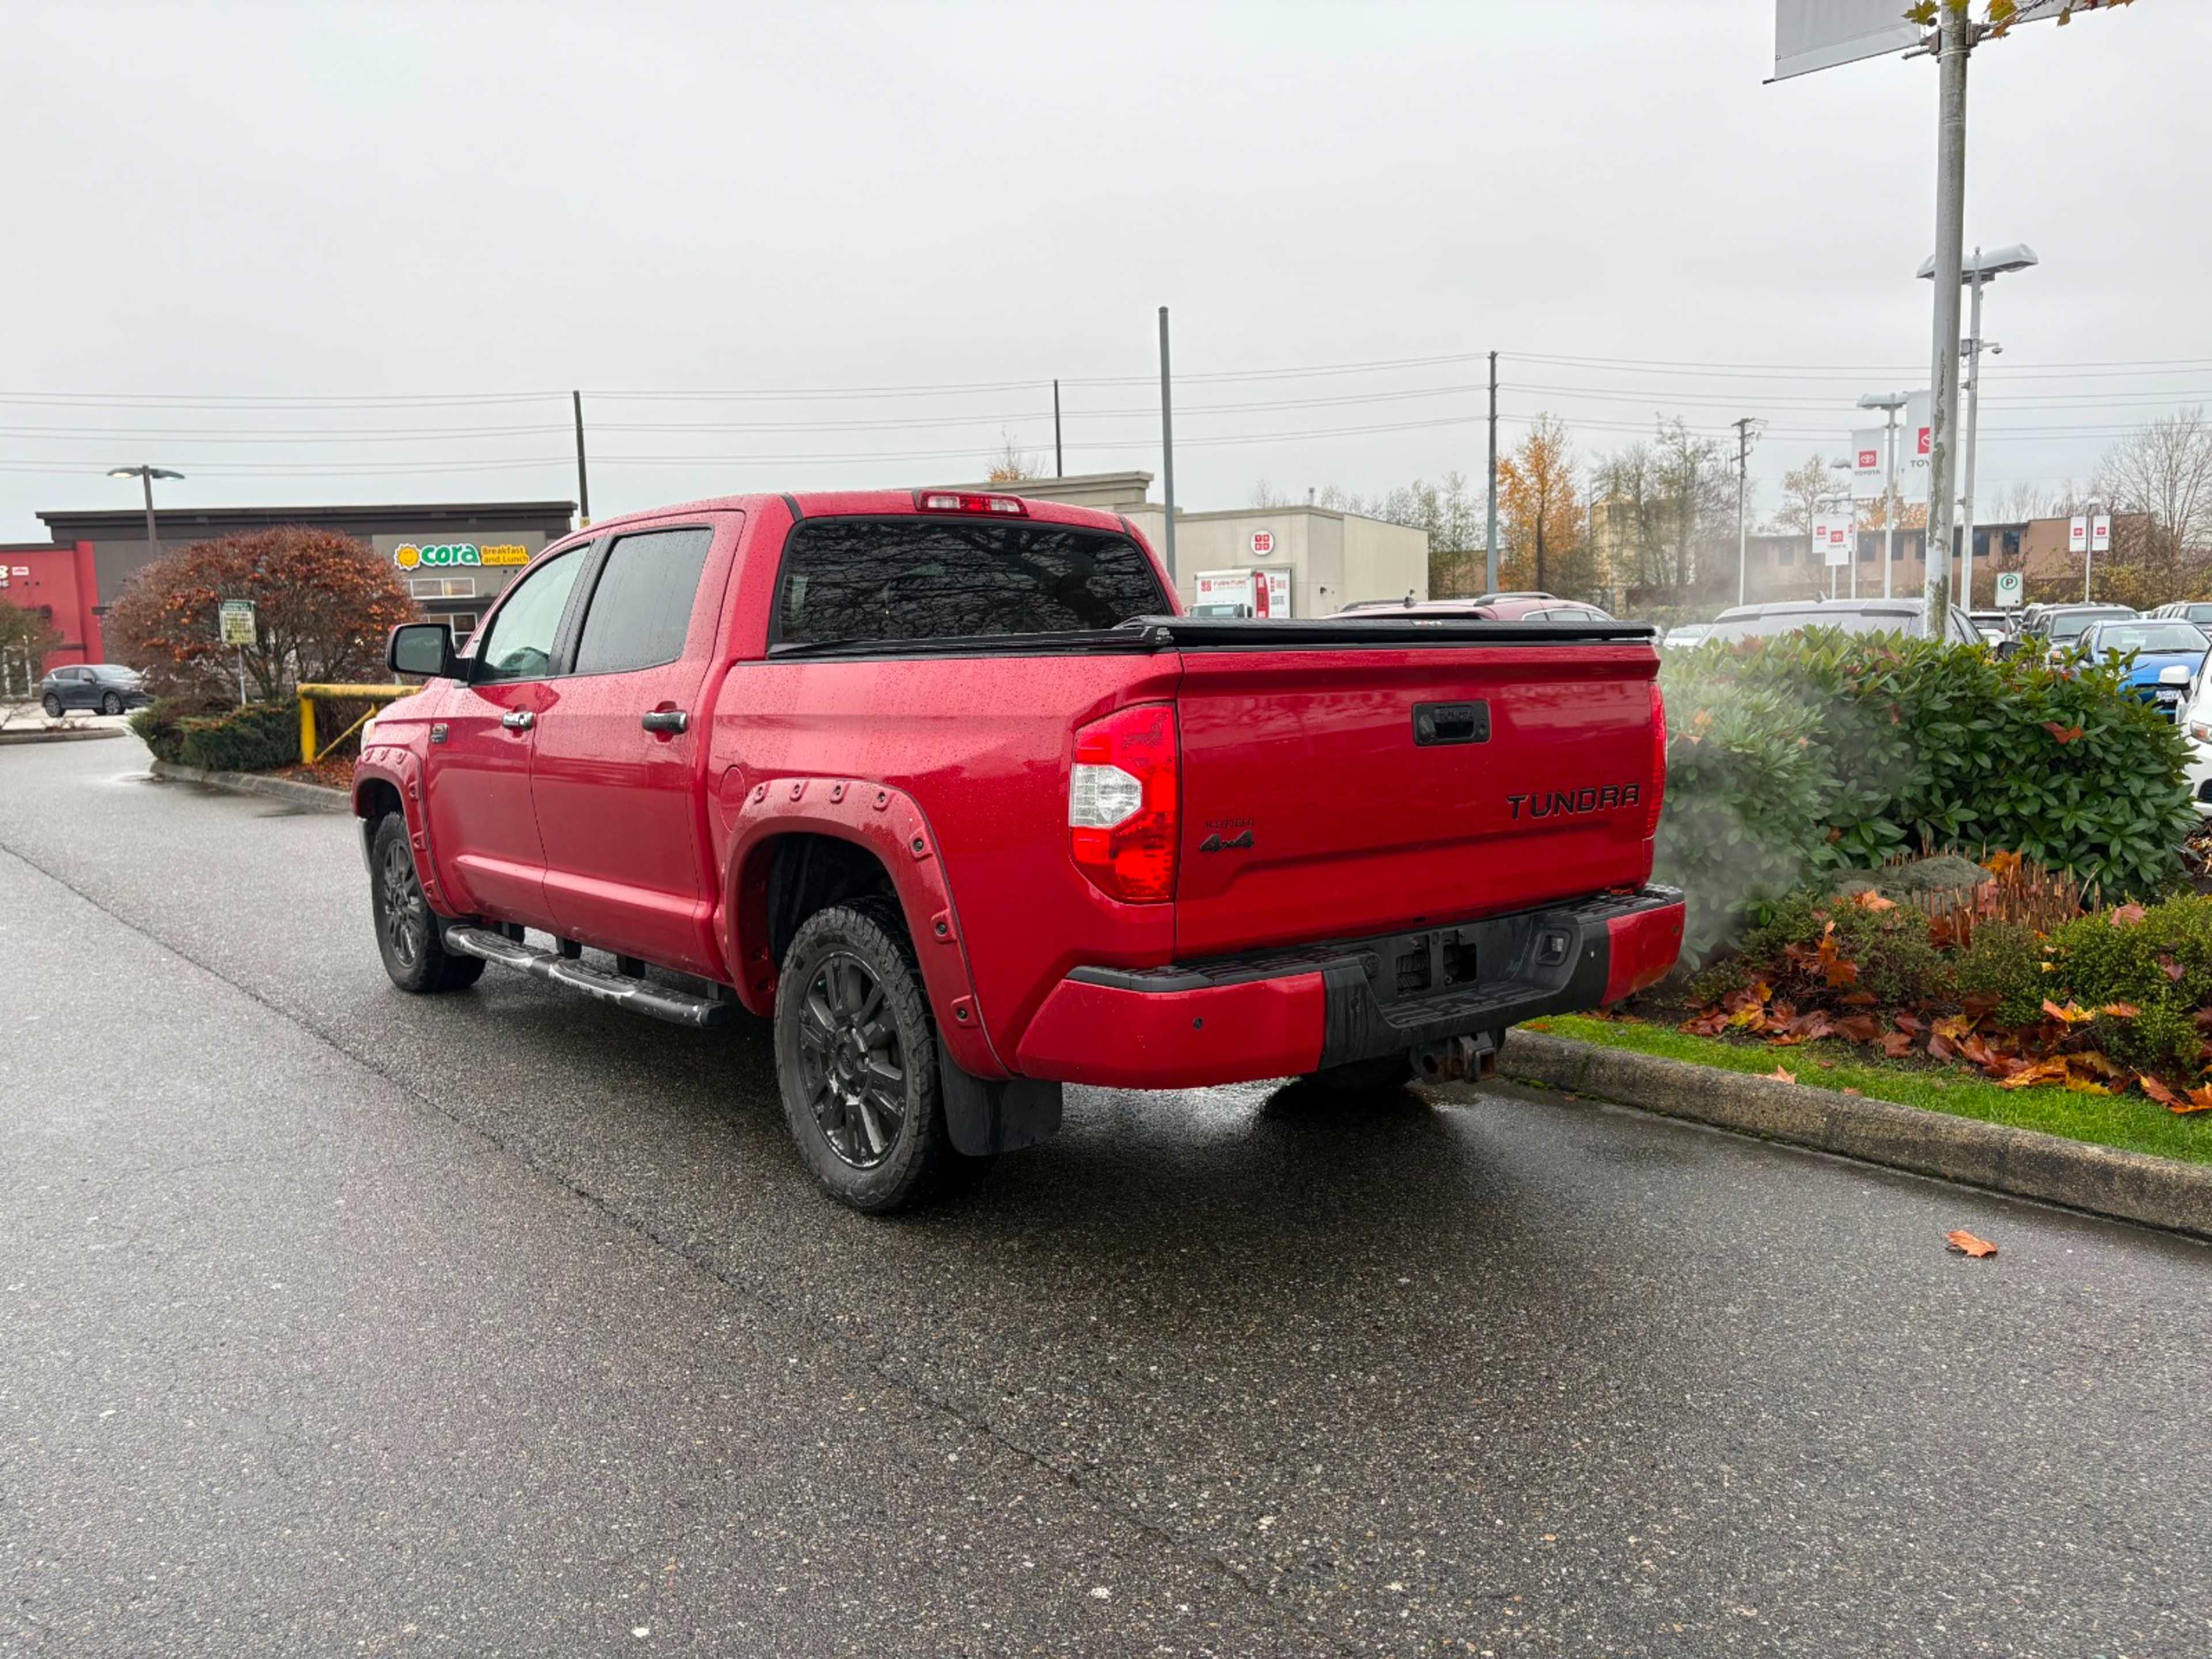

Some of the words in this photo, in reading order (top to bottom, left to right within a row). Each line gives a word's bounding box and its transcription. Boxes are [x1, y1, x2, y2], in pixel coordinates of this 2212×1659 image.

[421, 545, 479, 564] cora
[483, 546, 524, 555] Breakfast
[484, 554, 500, 563] and
[502, 554, 529, 563] Lunch
[2006, 578, 2013, 586] P
[1506, 782, 1640, 820] TUNDRA
[1199, 830, 1254, 853] 4x4
